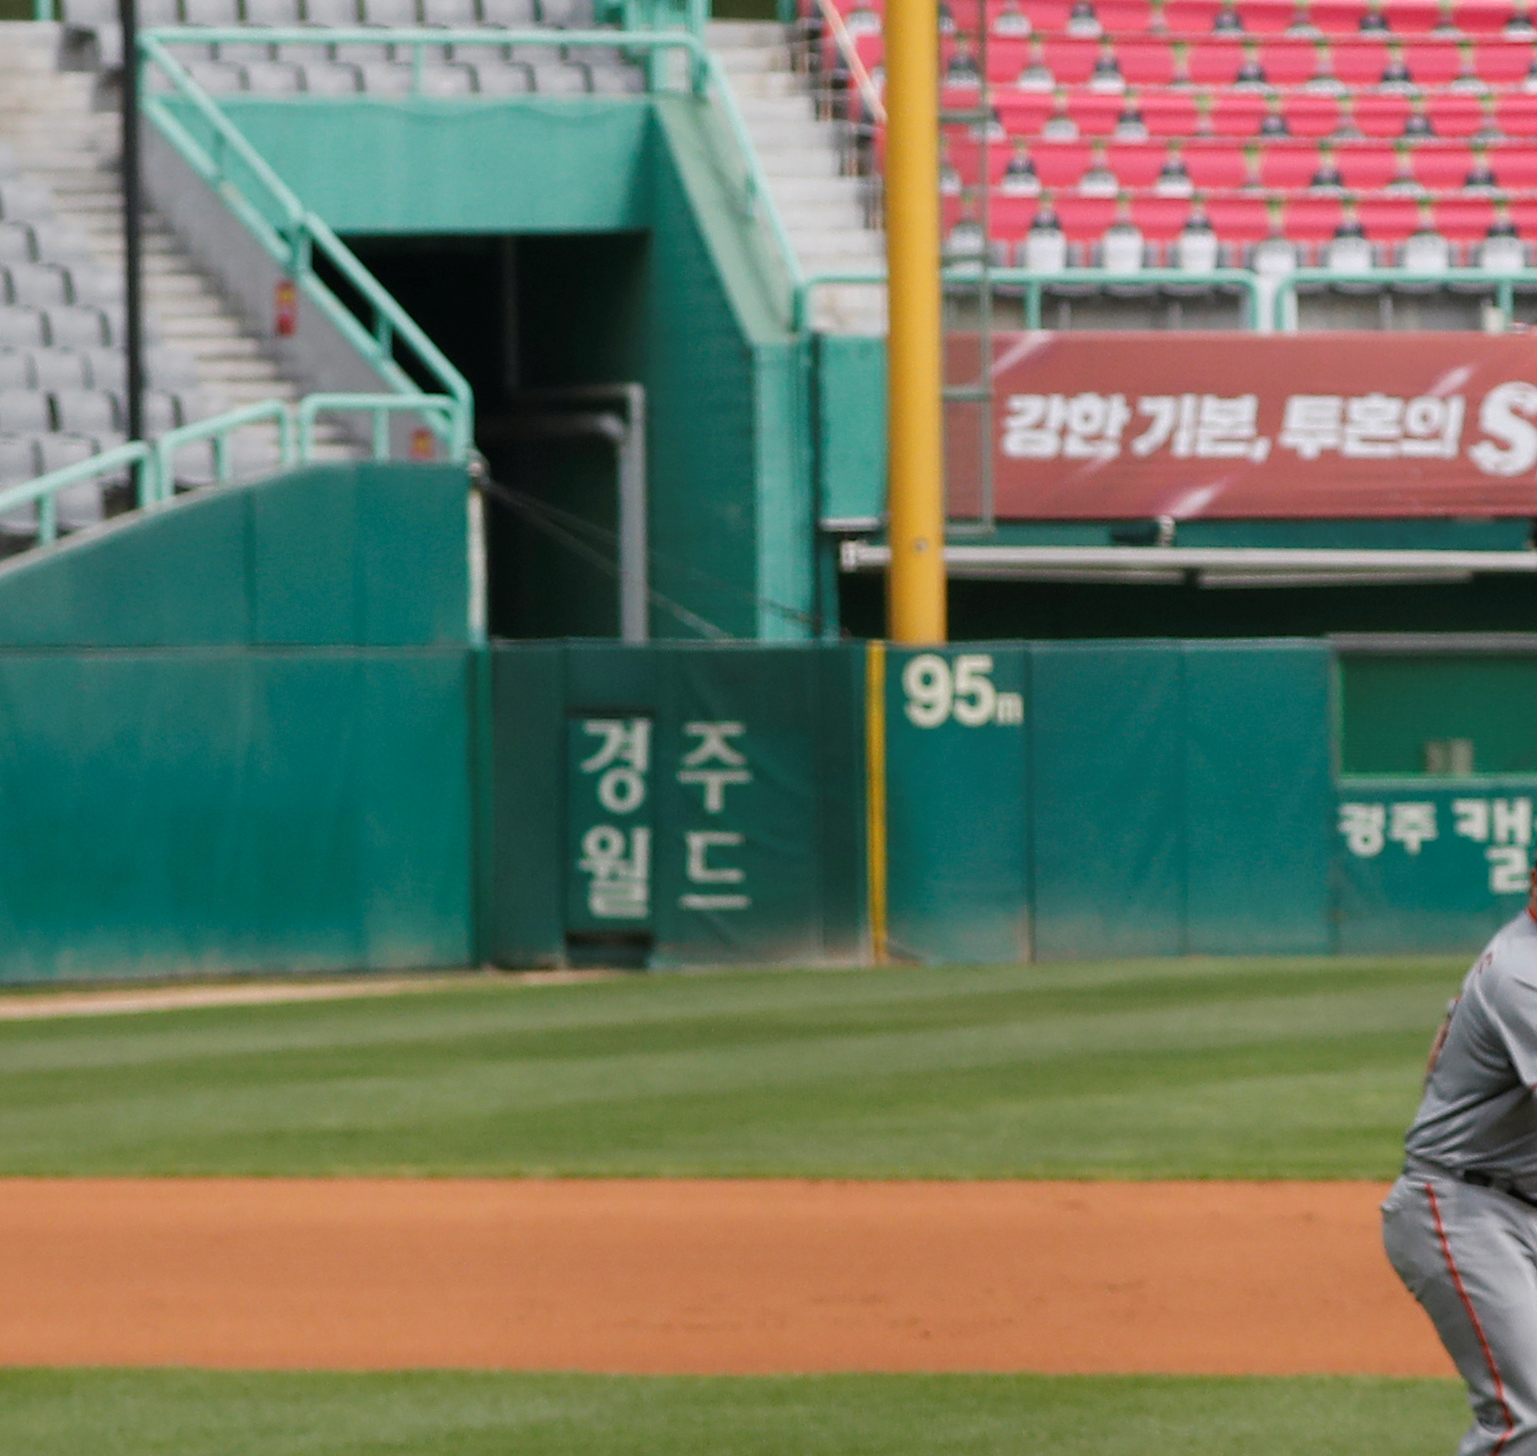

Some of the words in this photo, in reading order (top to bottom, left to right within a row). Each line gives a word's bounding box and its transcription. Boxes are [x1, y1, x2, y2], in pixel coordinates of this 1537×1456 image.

[1001, 393, 1131, 460] 강한
[1132, 393, 1271, 463] 기본,
[1277, 393, 1465, 461] 투혼의
[902, 653, 1024, 729] 95m
[580, 717, 753, 814] 경주
[578, 824, 752, 919] 월드
